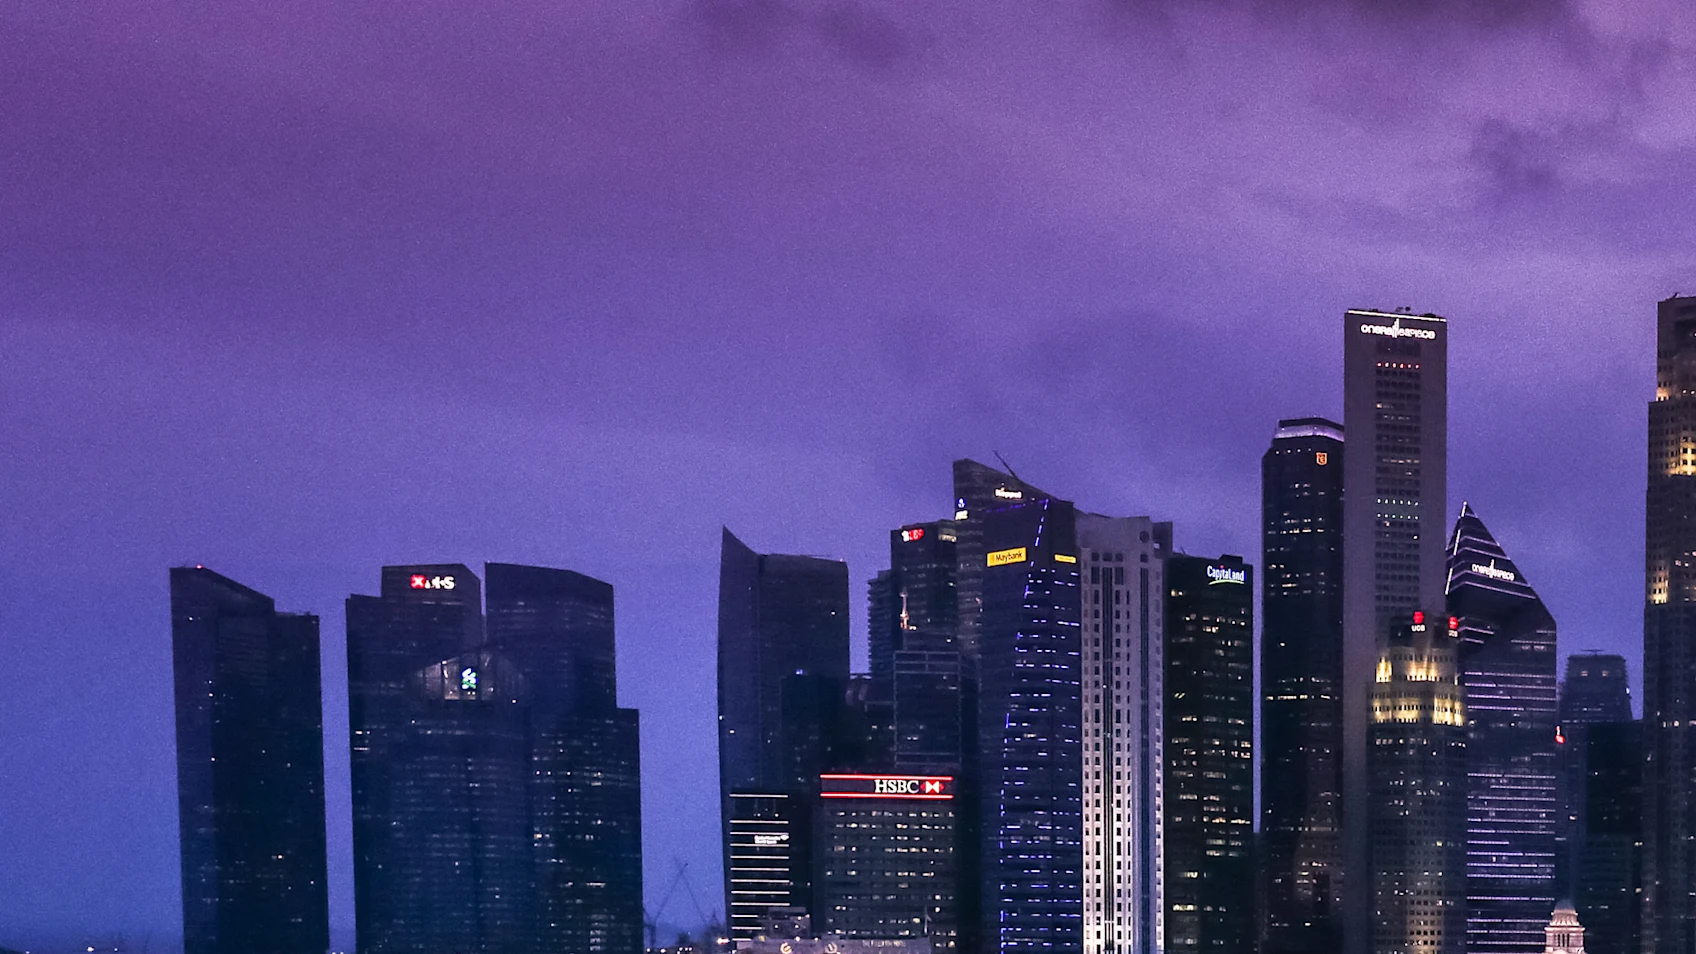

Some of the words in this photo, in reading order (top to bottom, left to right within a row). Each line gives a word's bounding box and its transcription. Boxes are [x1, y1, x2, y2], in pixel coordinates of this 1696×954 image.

[995, 551, 1023, 563] Maybank
[1207, 565, 1245, 581] CapitaLand
[1411, 624, 1426, 632] UOB
[874, 779, 920, 794] HSBC
